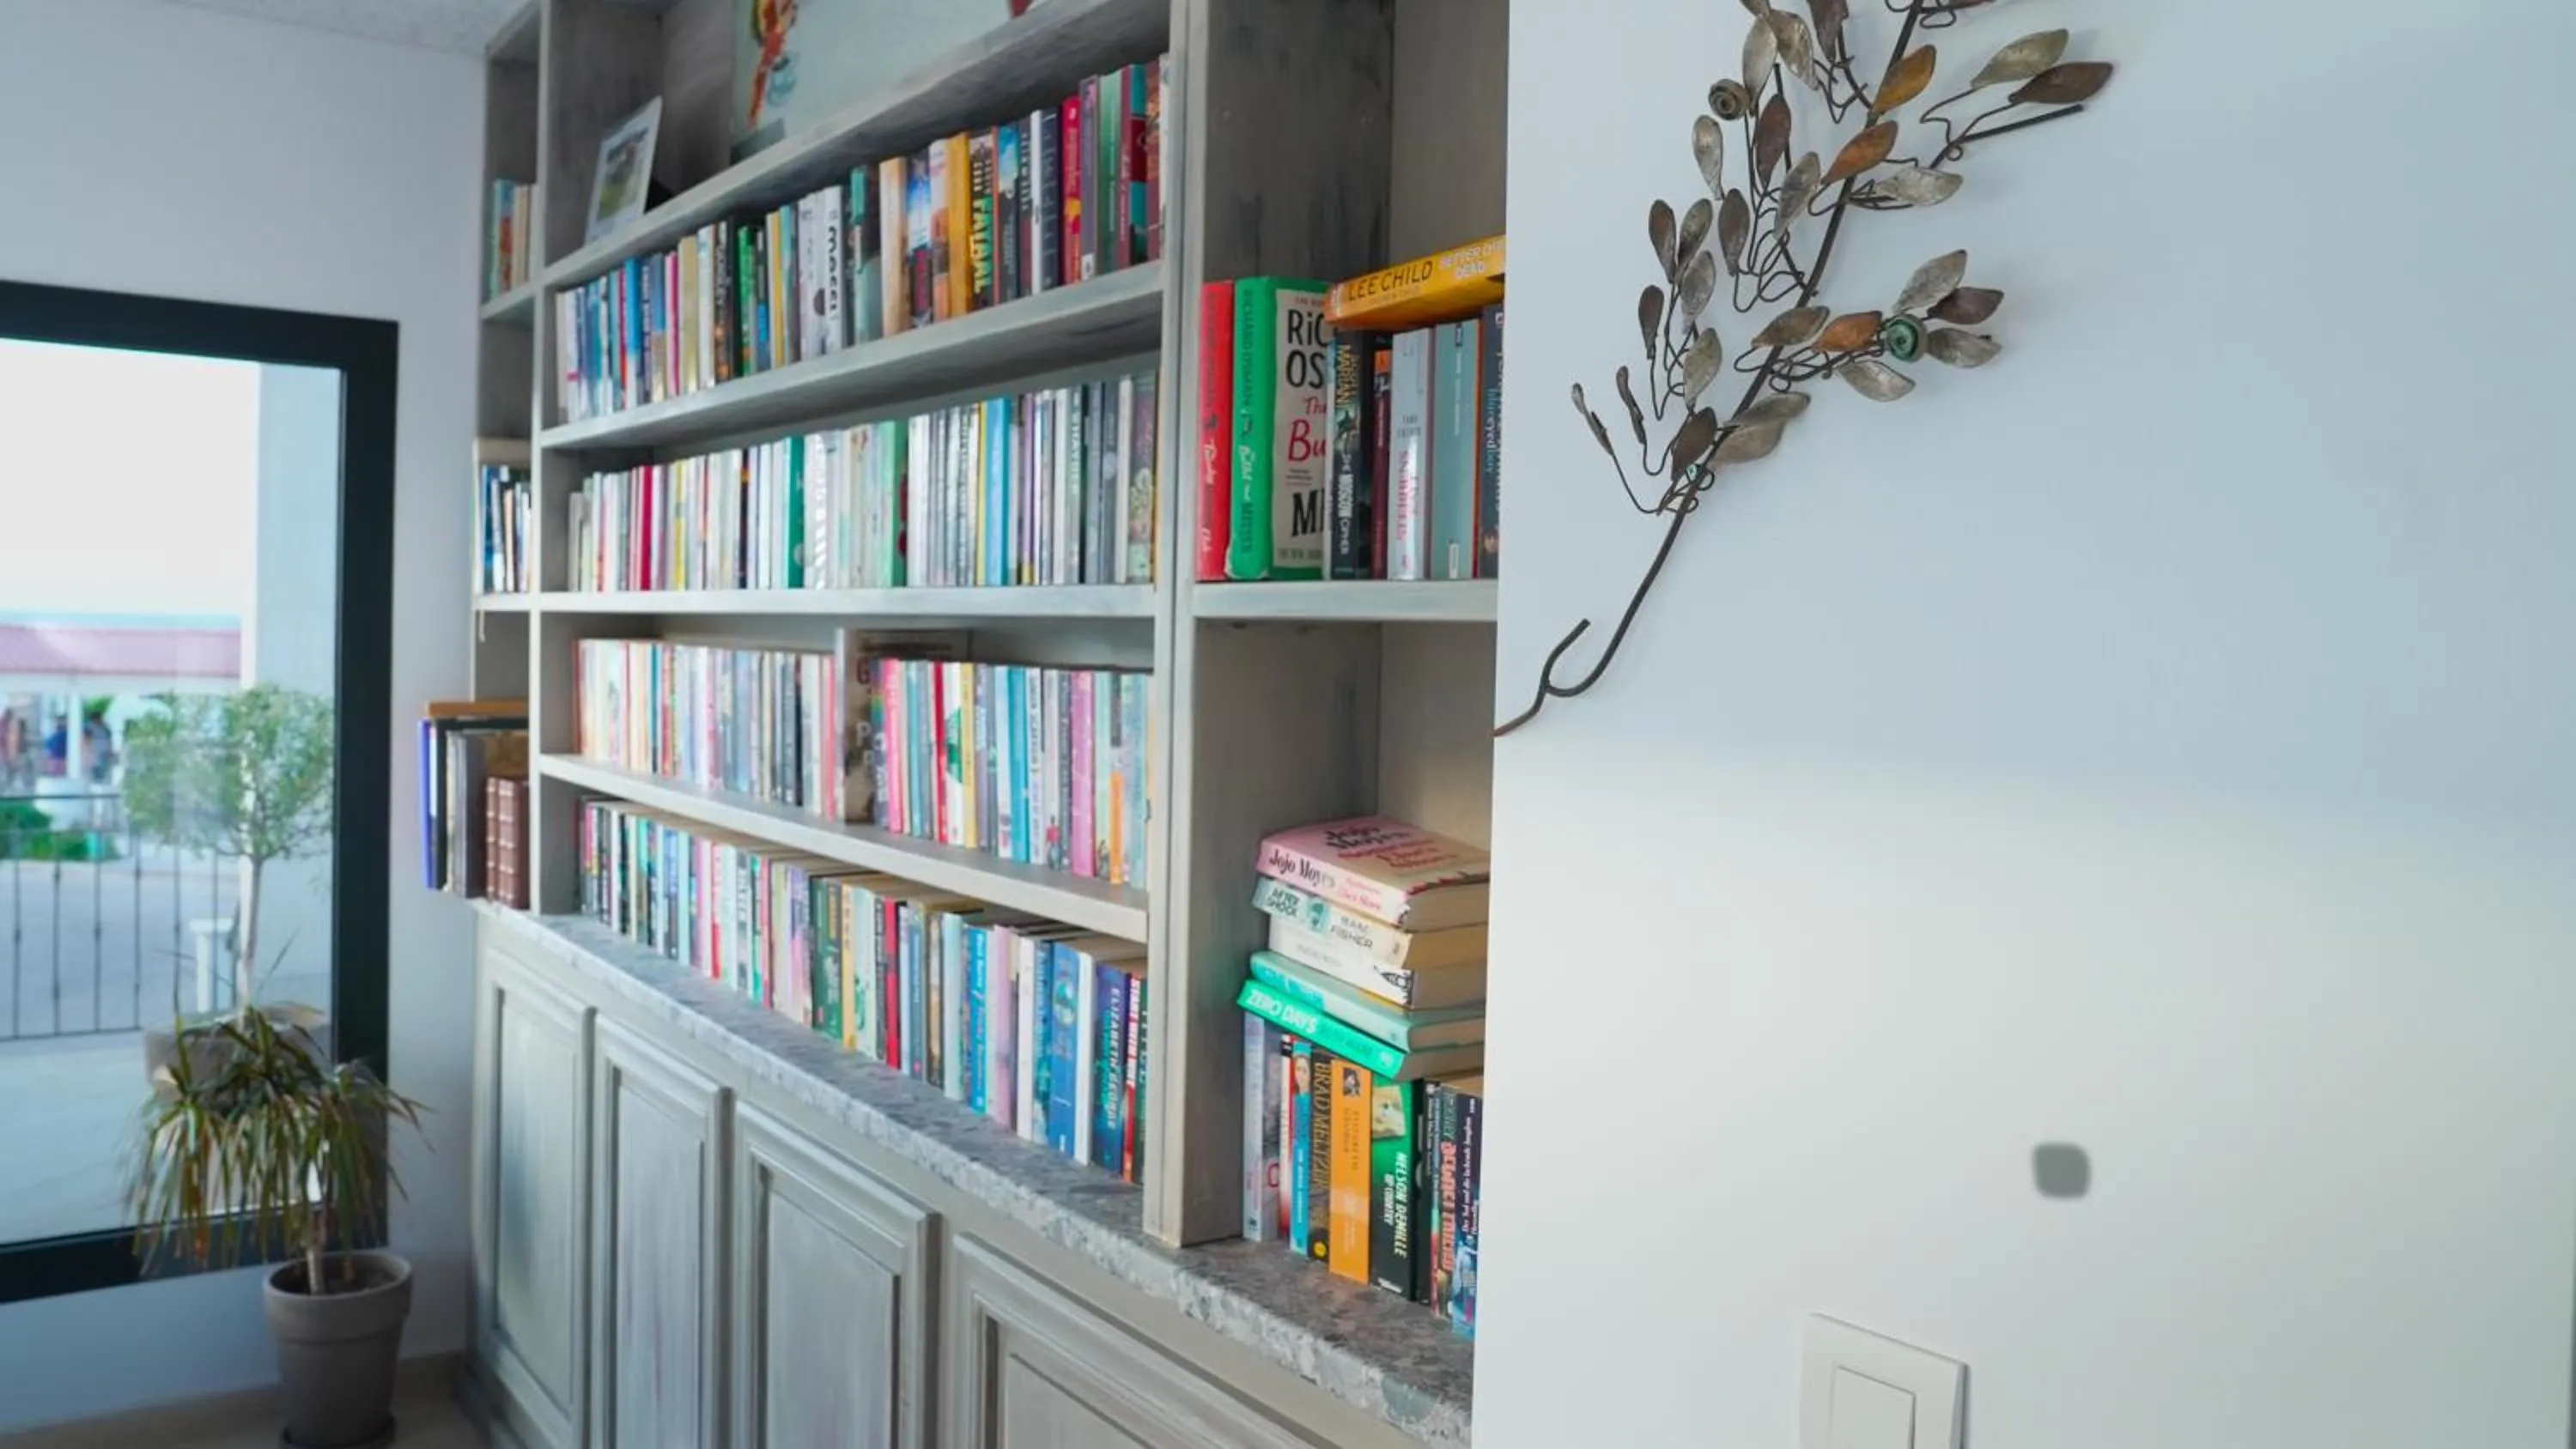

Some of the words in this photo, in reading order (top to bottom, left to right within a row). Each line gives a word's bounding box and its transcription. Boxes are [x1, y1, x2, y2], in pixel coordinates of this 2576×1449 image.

[1349, 276, 1377, 301] LEE
[1381, 260, 1433, 291] CHILD
[1287, 309, 1328, 348] RiC
[1285, 349, 1326, 390] OS
[1288, 419, 1326, 462] Bu
[1269, 849, 1296, 875] Jojo
[1299, 858, 1336, 889] Moyes
[1314, 1062, 1331, 1109] BRAD
[1394, 1151, 1407, 1203] NELSON
[1394, 1203, 1407, 1258] DEMILLE
